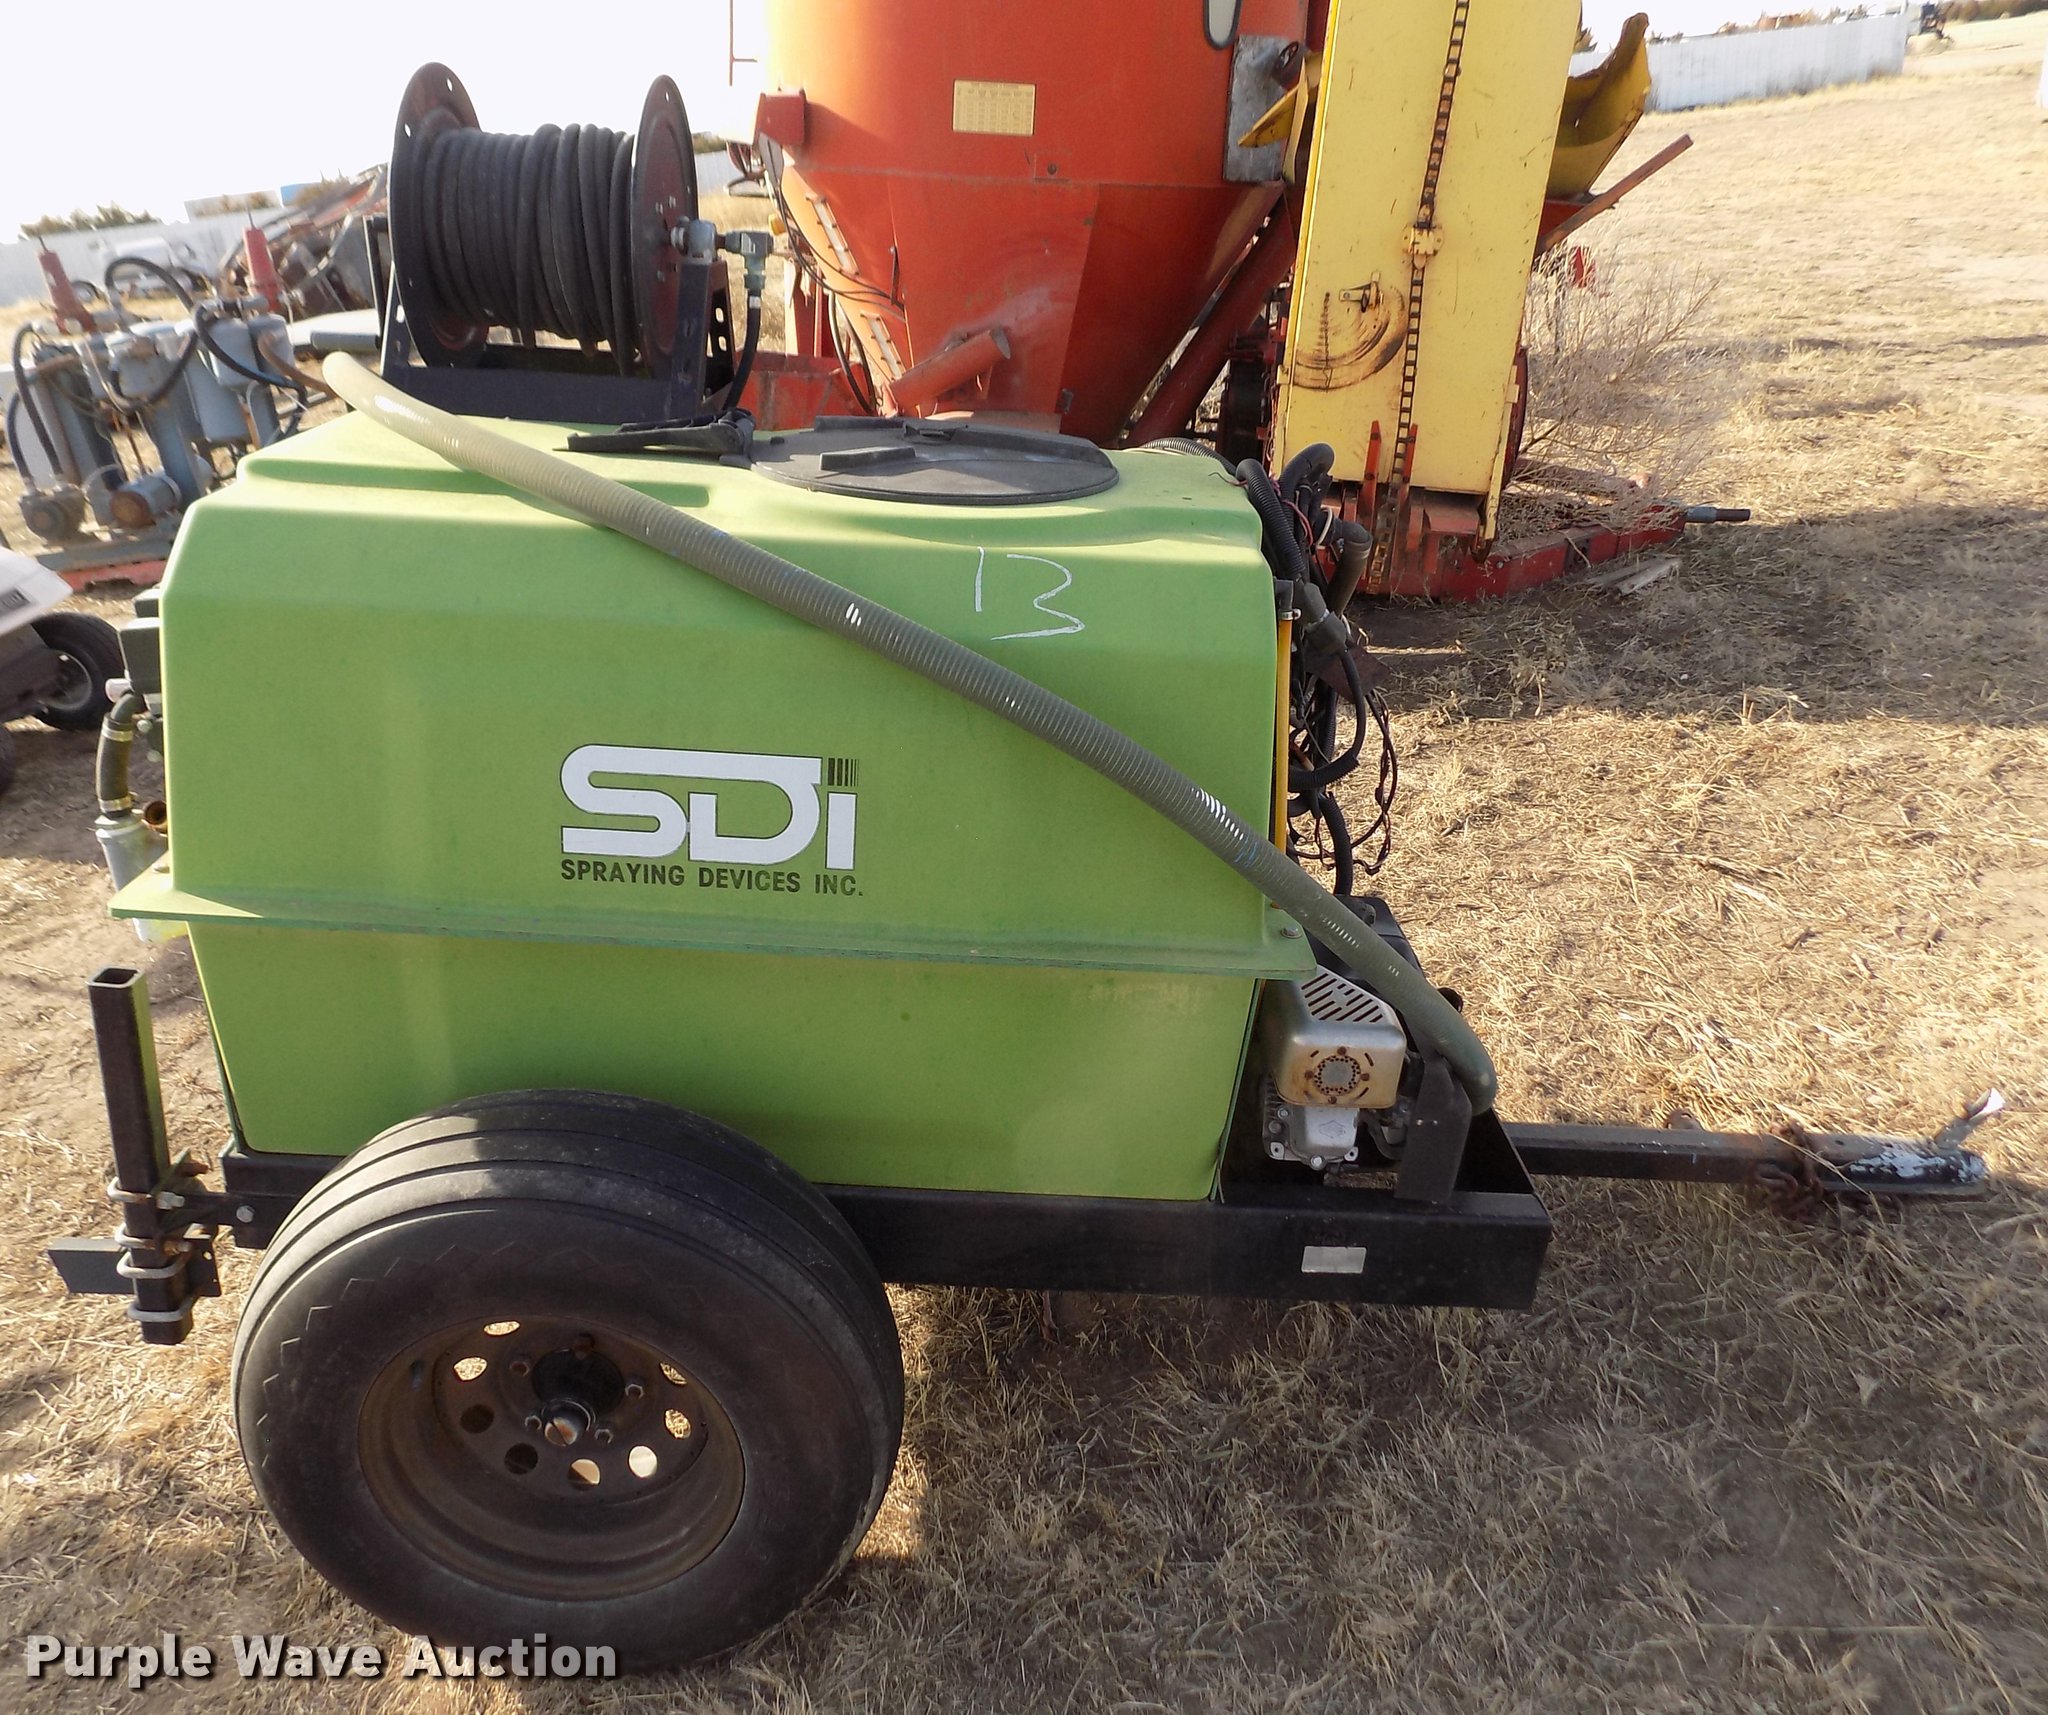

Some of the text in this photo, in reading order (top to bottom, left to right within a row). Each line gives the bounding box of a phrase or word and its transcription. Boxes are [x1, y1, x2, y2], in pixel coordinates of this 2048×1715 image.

[974, 546, 1085, 641] 13
[561, 859, 864, 897] SPRAYING DEVICES INC.
